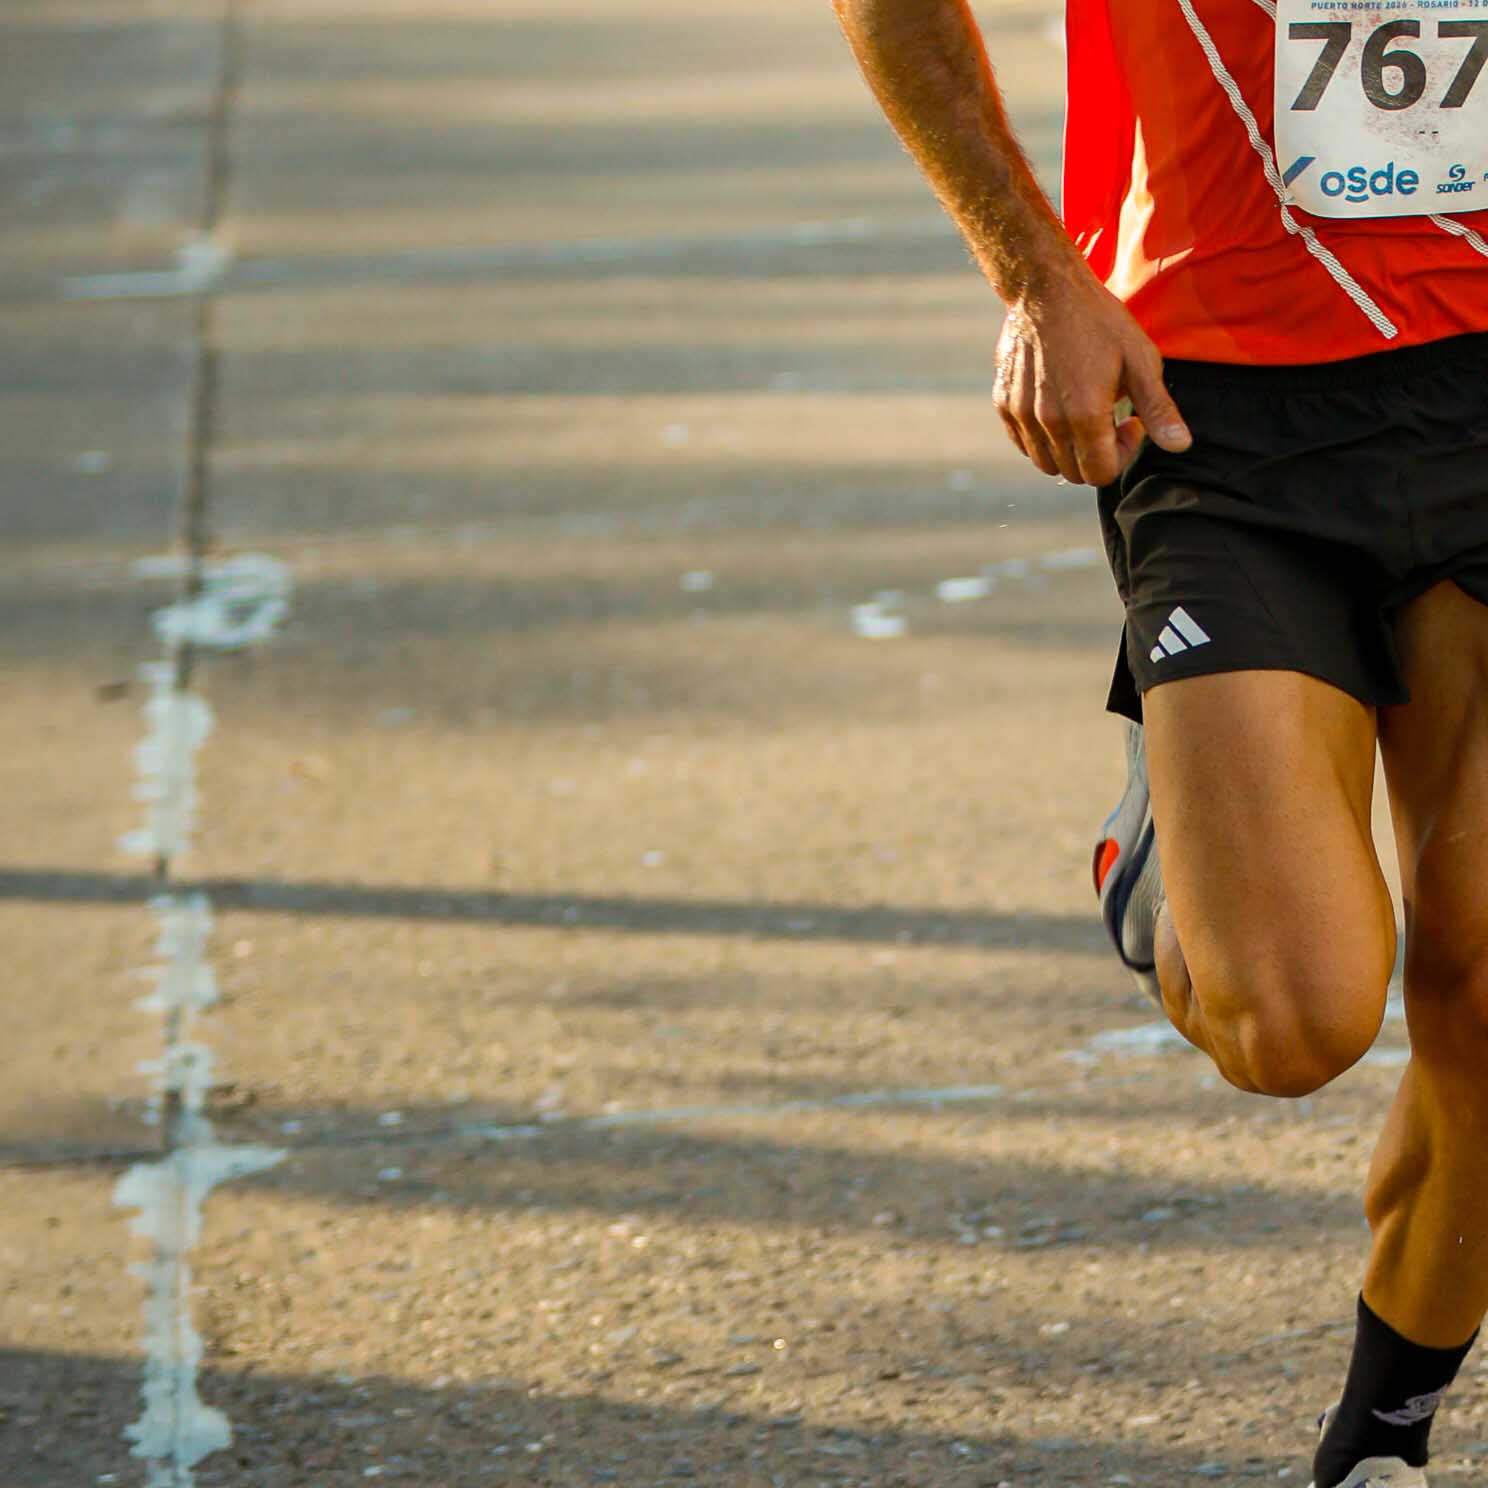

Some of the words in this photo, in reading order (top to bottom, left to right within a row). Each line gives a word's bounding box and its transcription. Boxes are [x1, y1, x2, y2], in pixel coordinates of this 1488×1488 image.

[1311, 1, 1348, 10] PUERTO
[1351, 1, 1381, 10] NORTE
[1417, 0, 1459, 9] ROSARIO
[1320, 160, 1419, 197] osde
